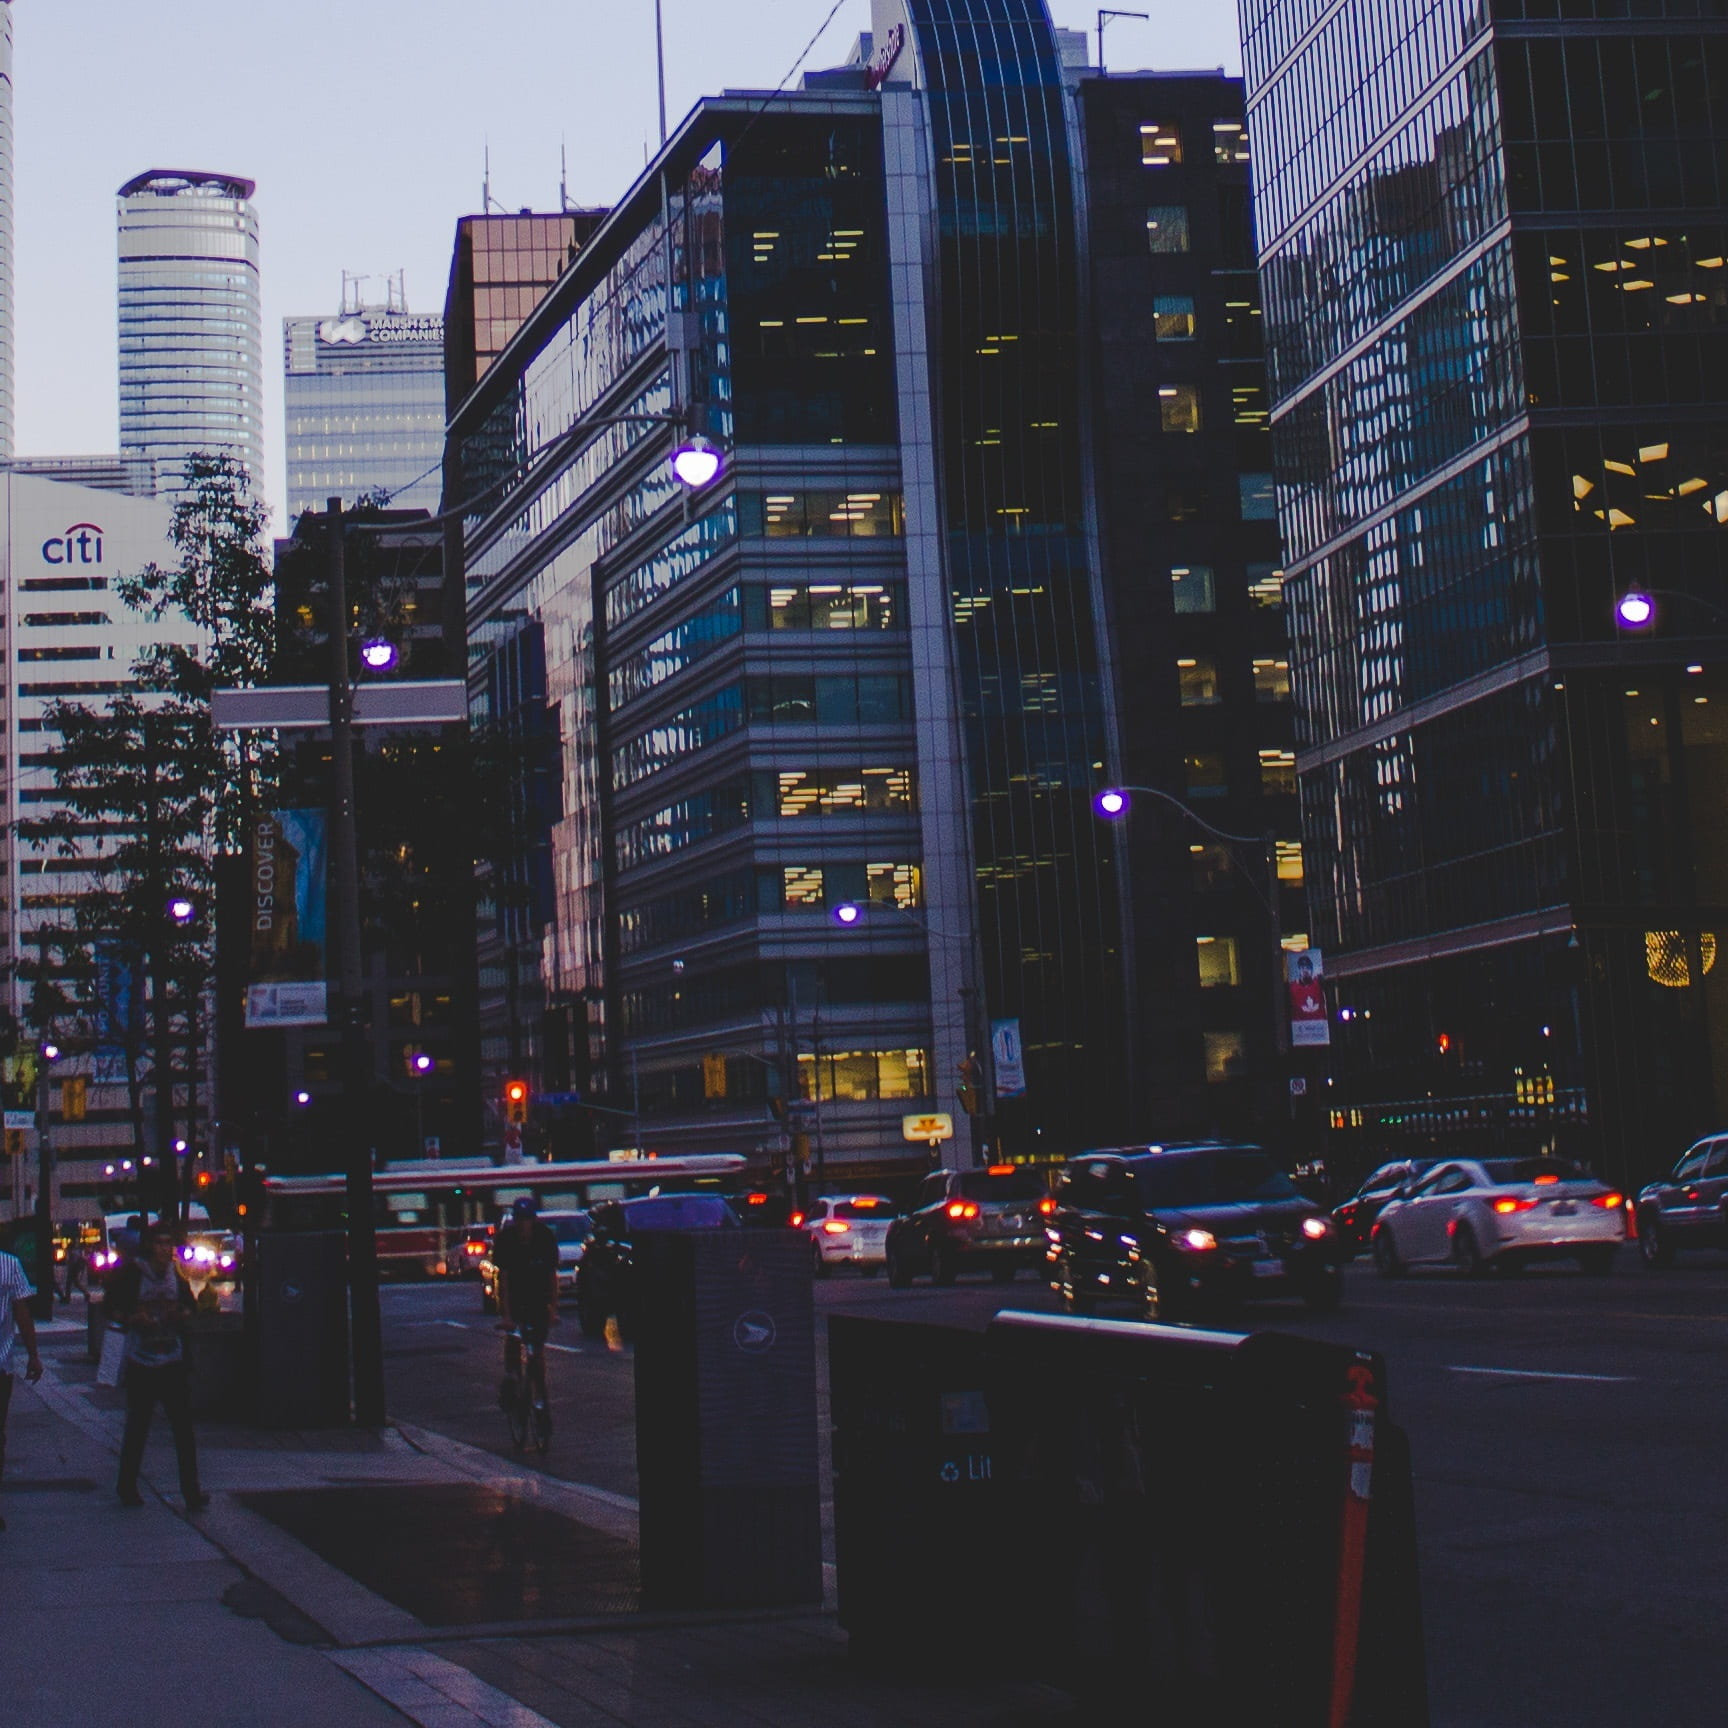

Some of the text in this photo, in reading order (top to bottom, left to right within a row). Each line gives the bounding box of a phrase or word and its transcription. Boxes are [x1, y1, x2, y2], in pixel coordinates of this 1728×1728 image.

[370, 318, 416, 329] MARSH
[42, 524, 103, 565] citi
[256, 821, 276, 932] DISCOVER
